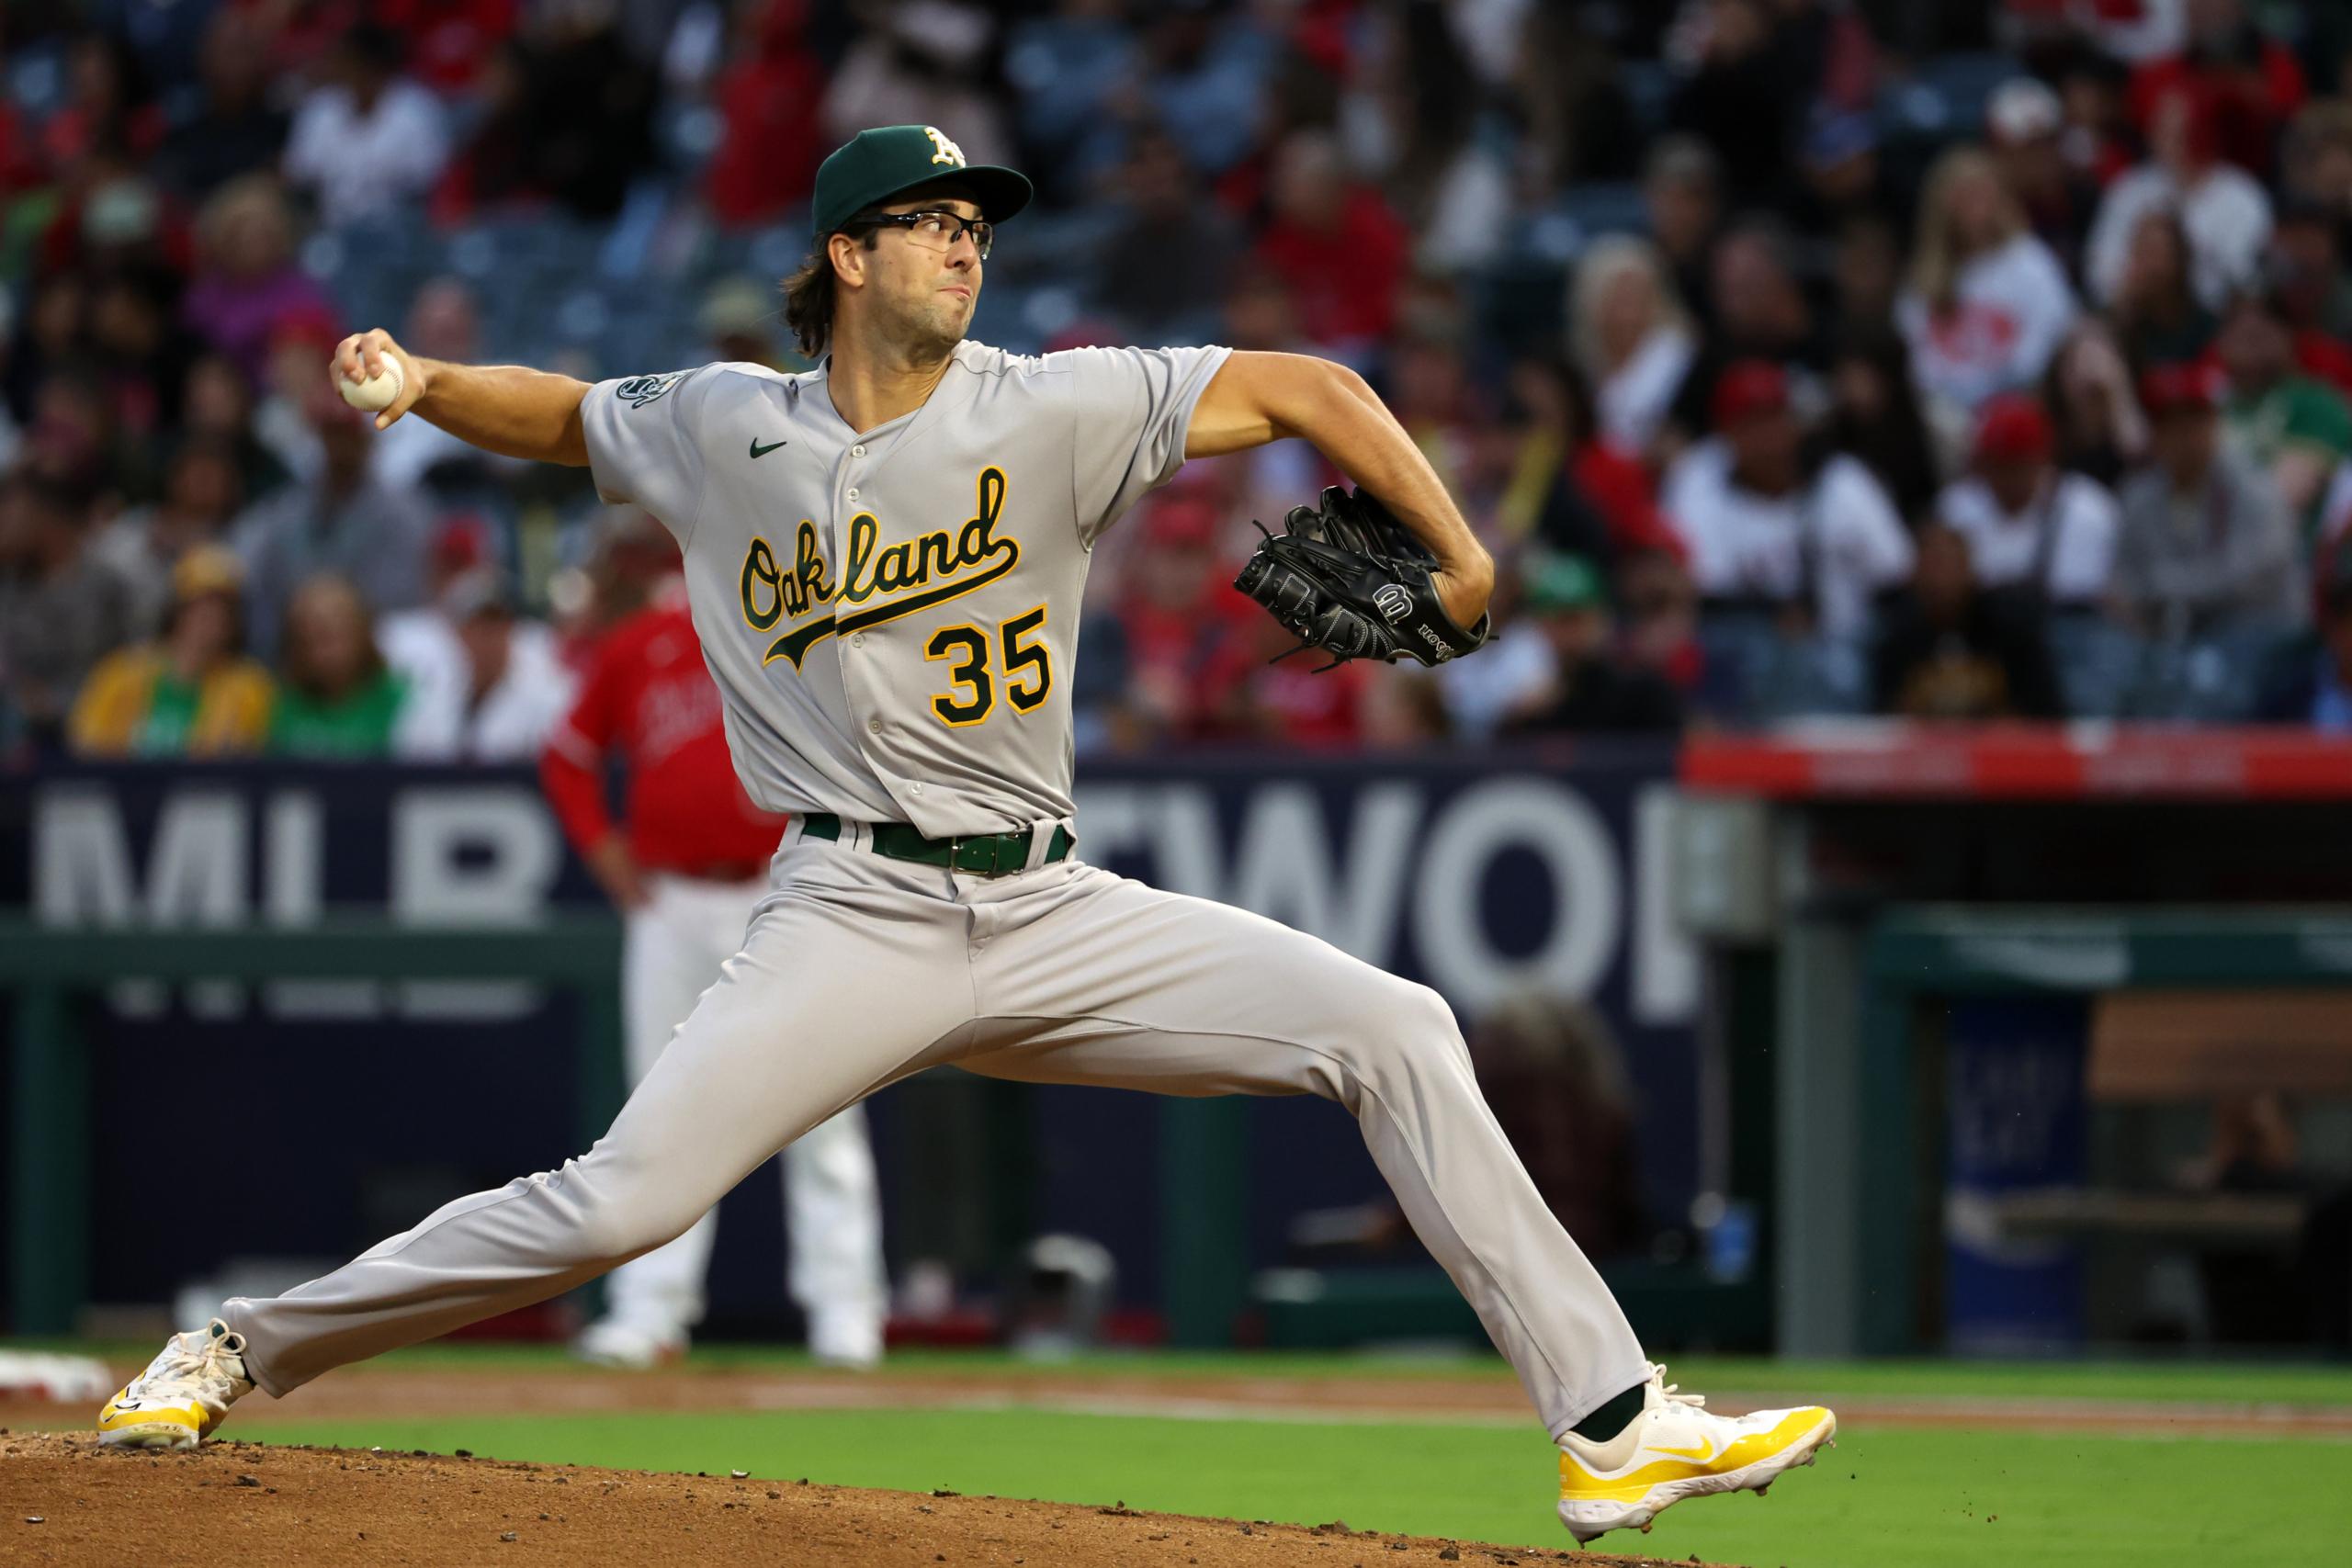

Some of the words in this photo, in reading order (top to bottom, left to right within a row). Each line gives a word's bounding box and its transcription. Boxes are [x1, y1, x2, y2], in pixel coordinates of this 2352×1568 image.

[741, 465, 1019, 634] Oakland
[924, 604, 1053, 728] 35
[33, 788, 553, 1016] MLB
